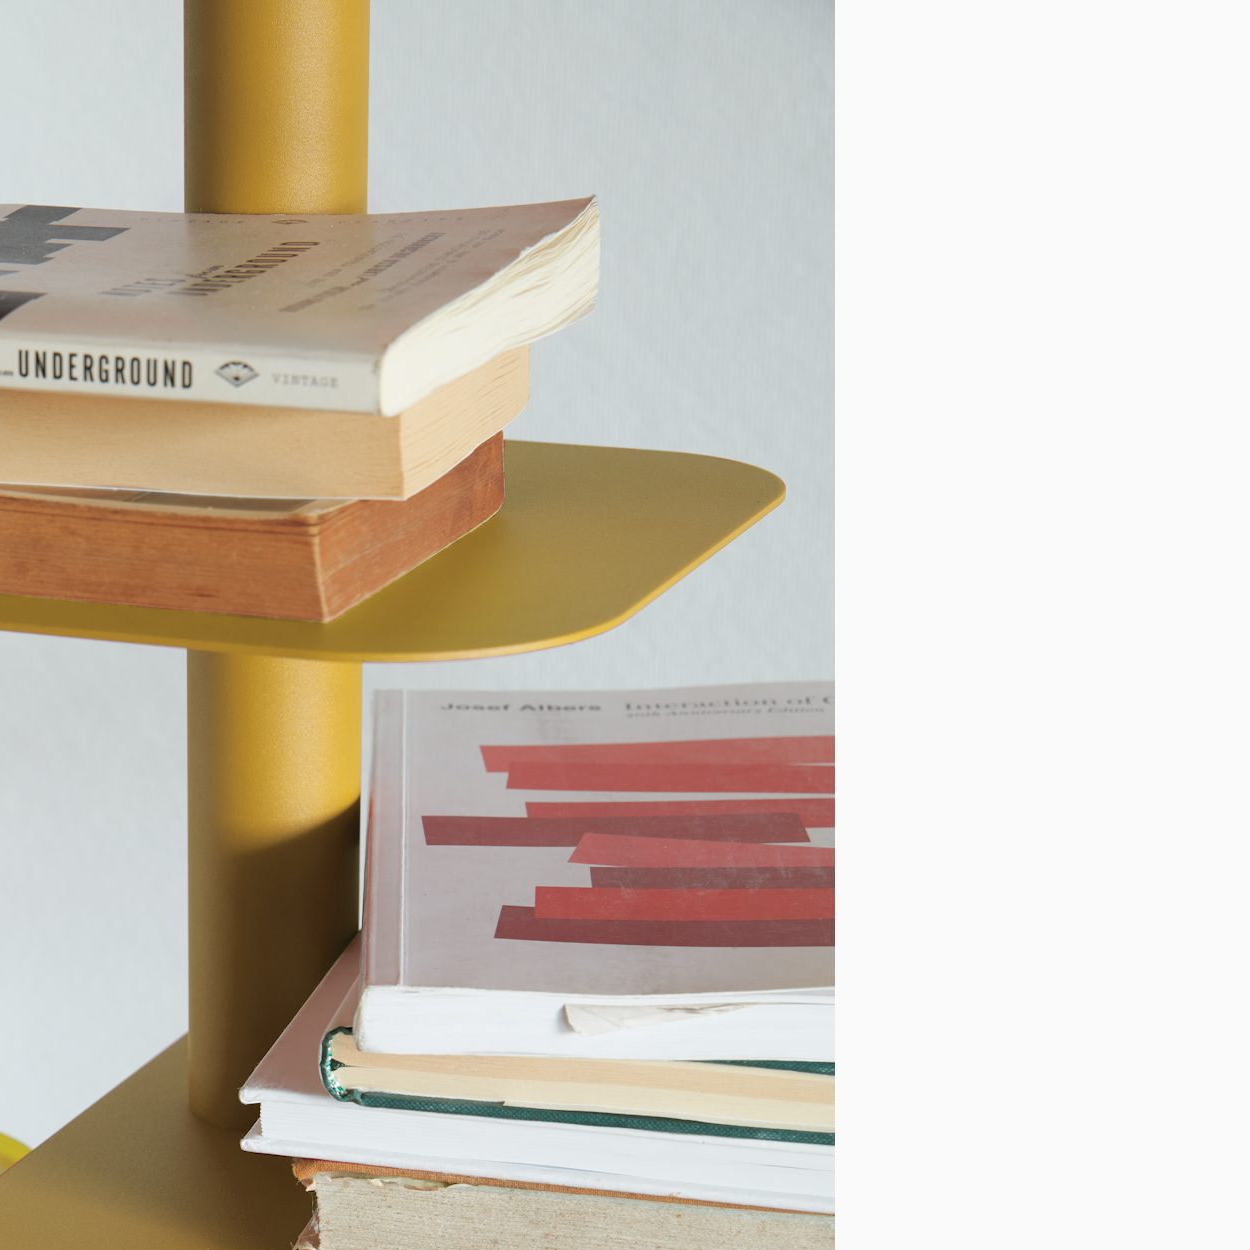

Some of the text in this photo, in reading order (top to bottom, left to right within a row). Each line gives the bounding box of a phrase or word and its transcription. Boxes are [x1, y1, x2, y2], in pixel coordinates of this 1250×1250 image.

[17, 349, 193, 389] UNDERGROUND
[270, 372, 340, 389] VINTAGE
[440, 703, 602, 712] Josef Albers
